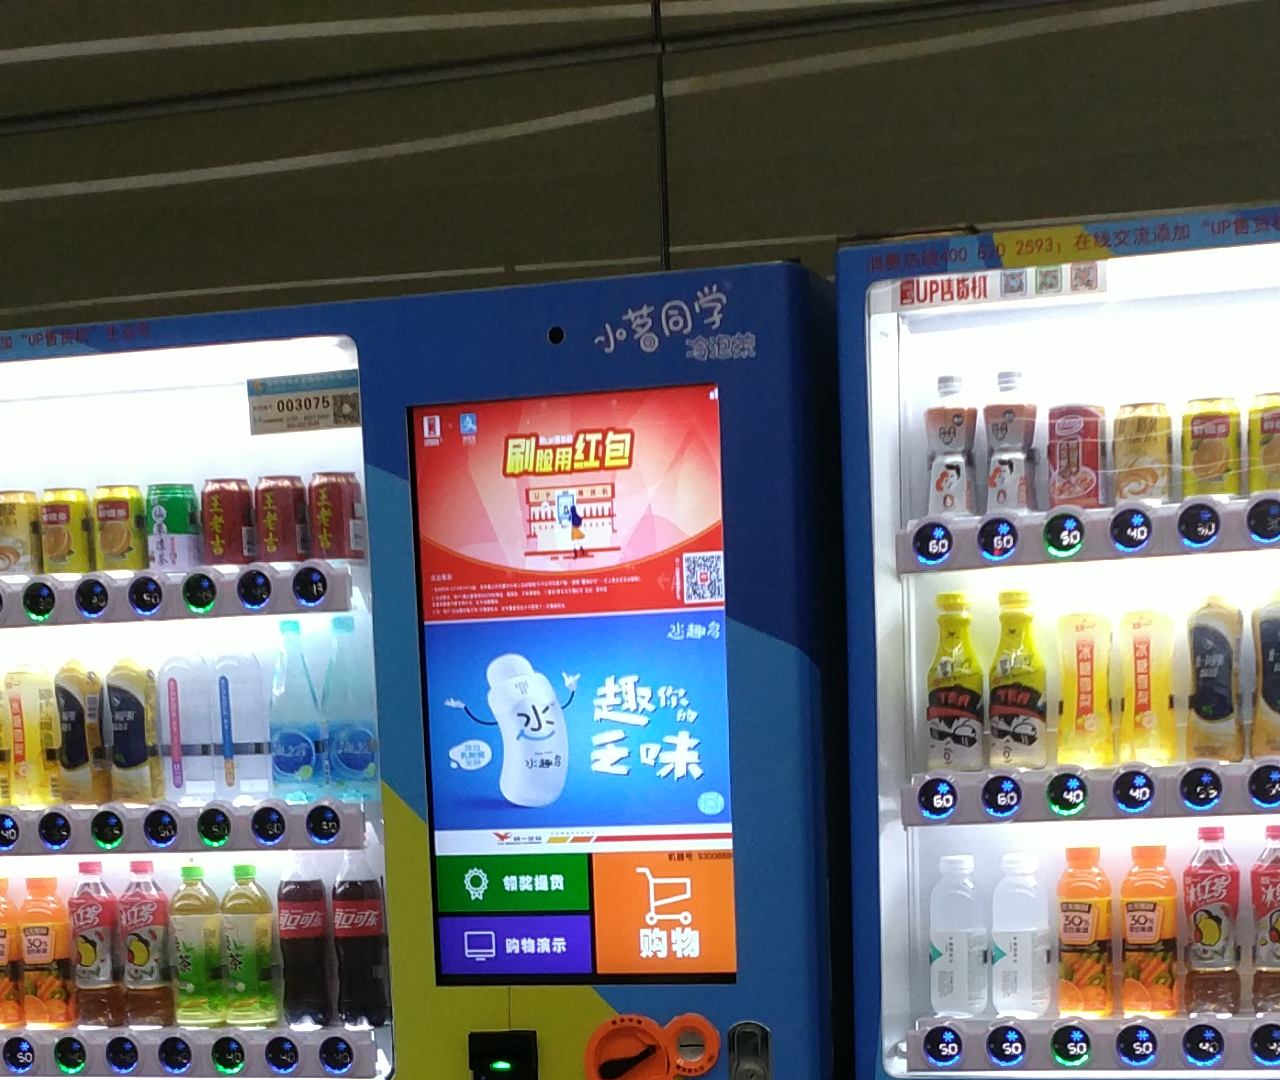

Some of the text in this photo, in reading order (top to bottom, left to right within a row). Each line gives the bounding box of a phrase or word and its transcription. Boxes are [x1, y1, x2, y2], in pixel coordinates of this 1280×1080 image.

[595, 283, 728, 353] 小茗同学
[685, 331, 756, 361] 冷泡茶
[504, 429, 632, 476] 刷脸用红包
[502, 873, 565, 892] 领奖提货
[505, 936, 567, 955] 购物演示
[638, 927, 700, 959] 购物
